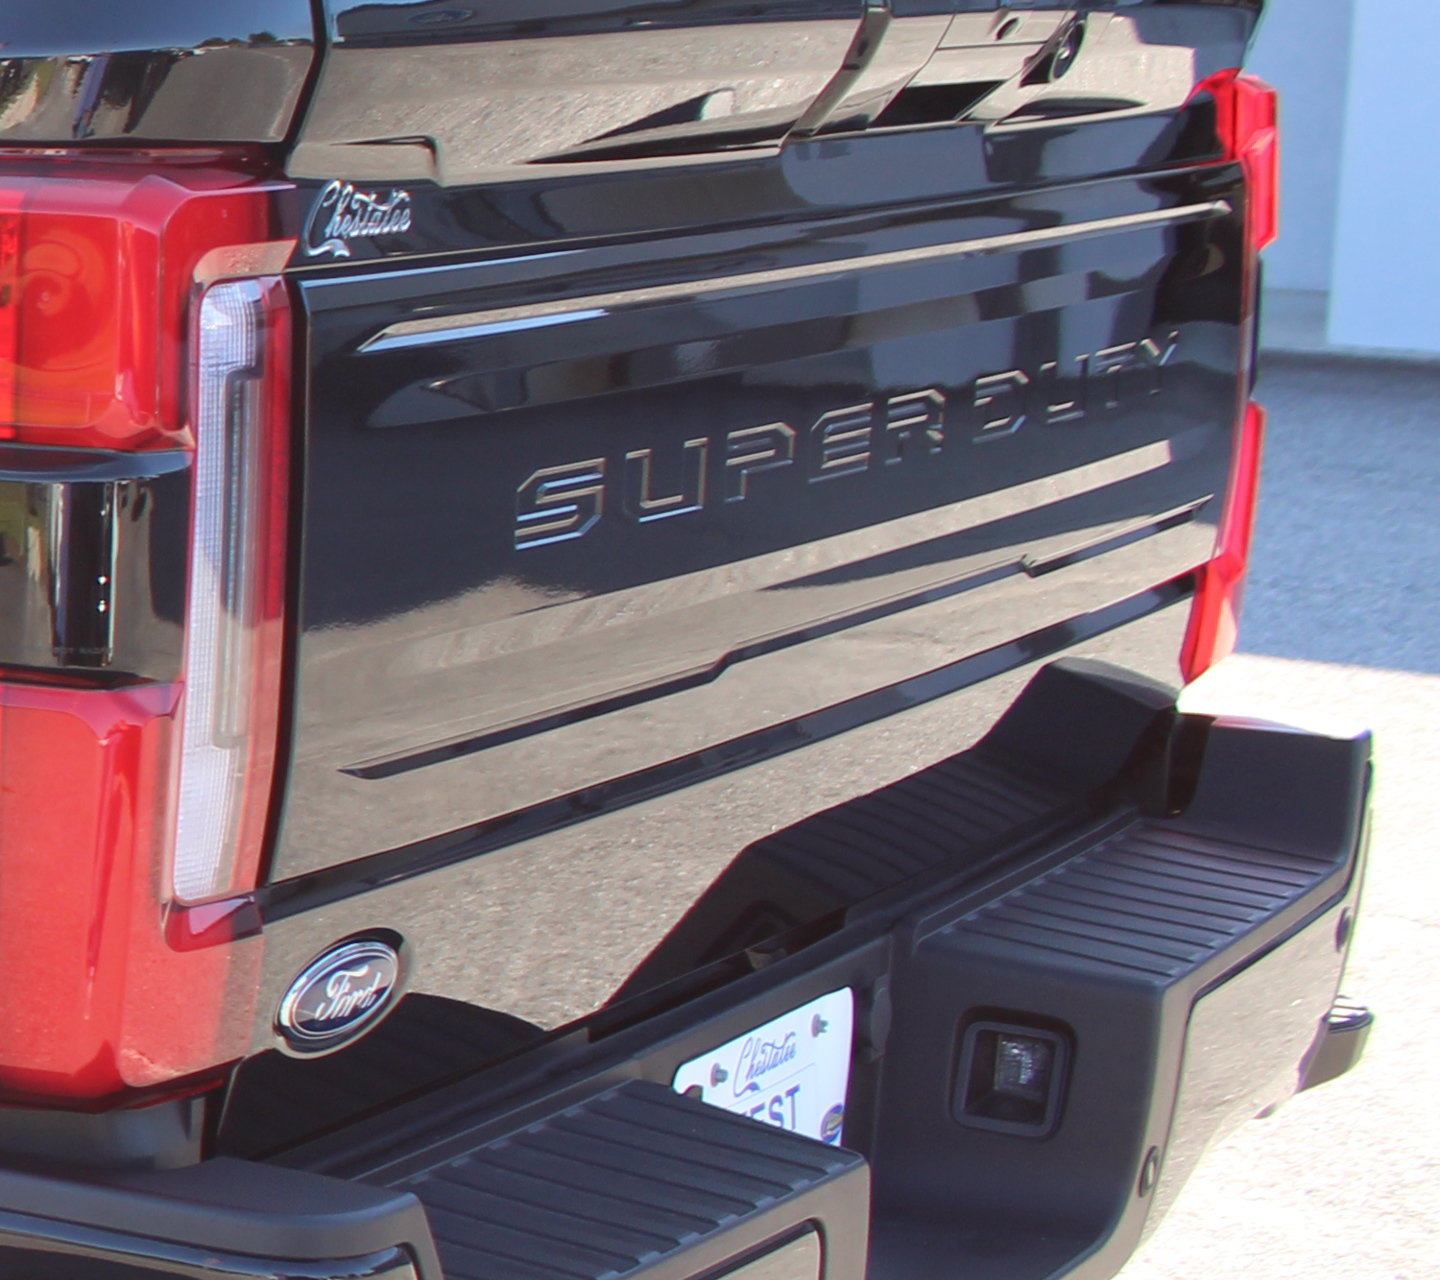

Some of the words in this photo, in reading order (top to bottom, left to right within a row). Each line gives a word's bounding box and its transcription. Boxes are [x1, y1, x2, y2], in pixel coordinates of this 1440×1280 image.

[514, 388, 946, 552] SUPER
[972, 330, 1180, 445] DUTY
[314, 964, 383, 1022] Ford
